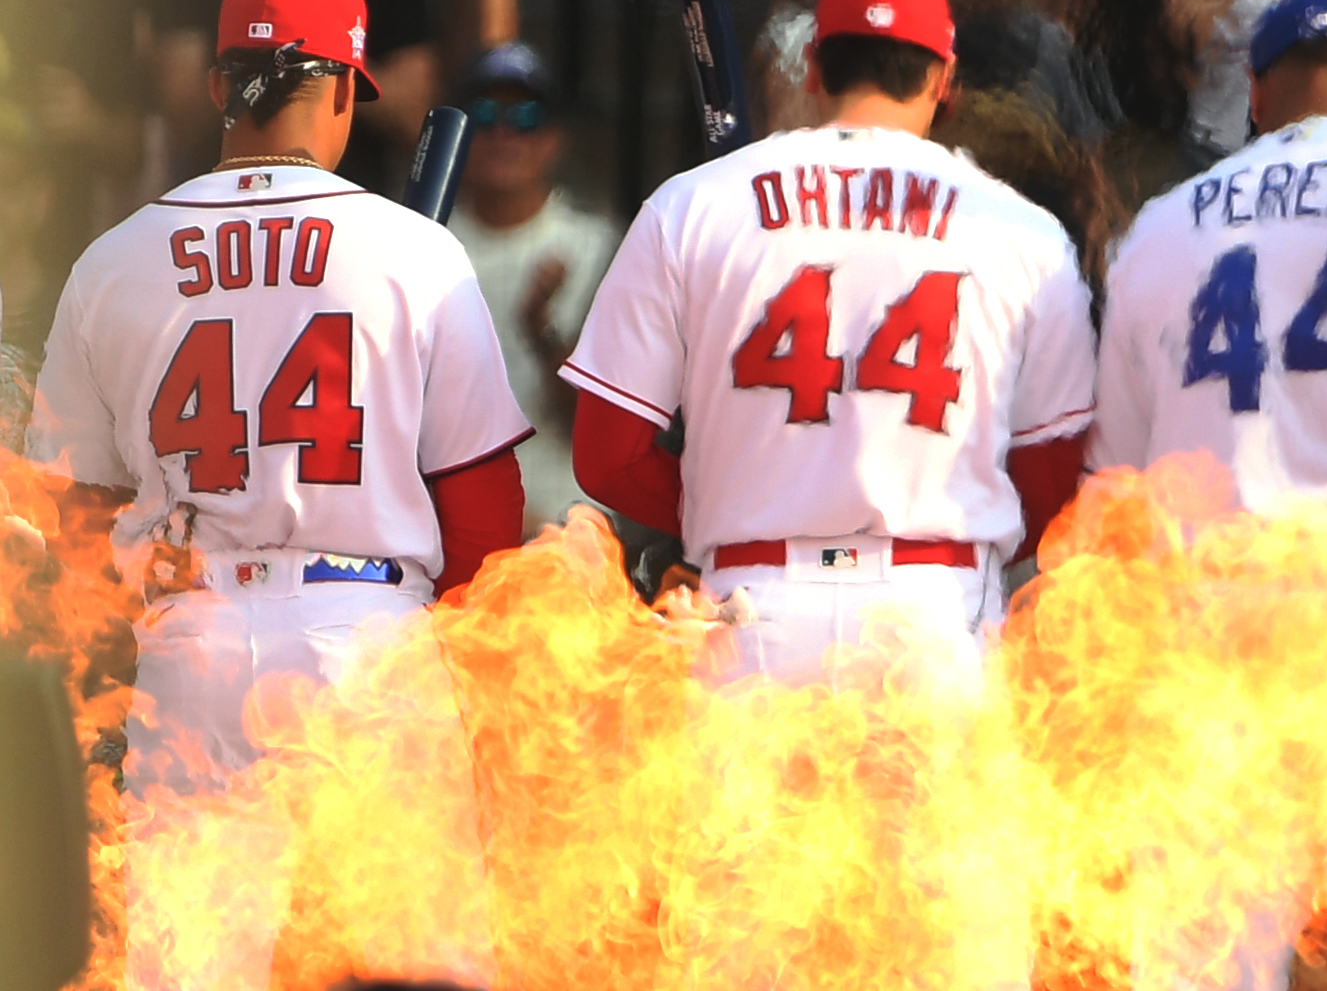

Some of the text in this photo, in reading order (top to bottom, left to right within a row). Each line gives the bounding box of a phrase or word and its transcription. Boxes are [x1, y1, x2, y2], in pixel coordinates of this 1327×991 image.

[169, 216, 335, 298] SOTO
[751, 164, 960, 242] OHTANI
[148, 311, 365, 494] 44
[731, 264, 971, 435] 44
